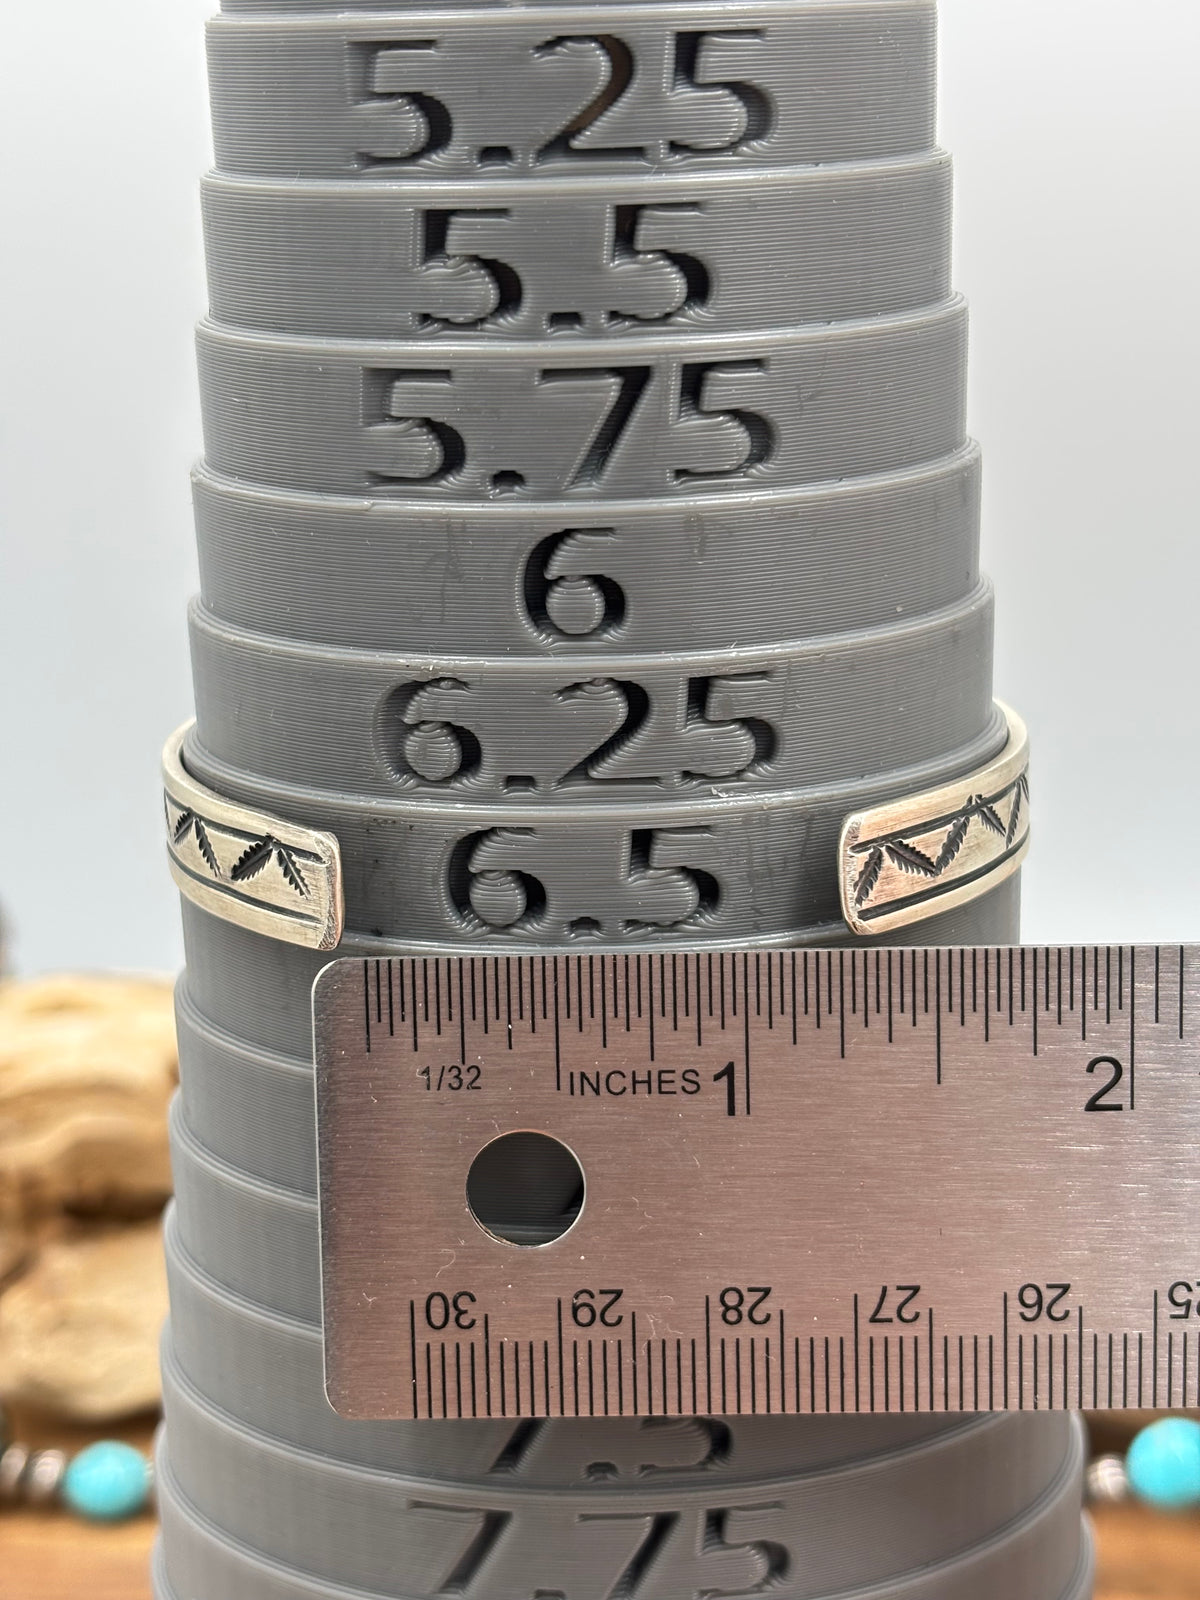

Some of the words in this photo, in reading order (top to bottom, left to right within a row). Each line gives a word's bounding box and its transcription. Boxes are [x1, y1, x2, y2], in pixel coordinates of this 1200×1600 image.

[346, 29, 778, 170] 5.25
[409, 201, 717, 332] 5.5
[360, 358, 779, 496] 5.75
[517, 528, 629, 645] 6
[373, 671, 782, 795] 6.25
[438, 826, 724, 937] 6.5
[418, 1064, 482, 1092] 1/32
[569, 1068, 701, 1096] INCHES
[712, 1061, 736, 1117] 1
[1084, 1055, 1123, 1112] 2
[425, 1290, 477, 1330] 30
[571, 1288, 624, 1327] 29
[719, 1286, 772, 1325] 28
[868, 1284, 921, 1323] 27
[1018, 1283, 1071, 1322] 26
[1167, 1280, 1200, 1319] 5
[407, 1500, 791, 1600] 7.75
